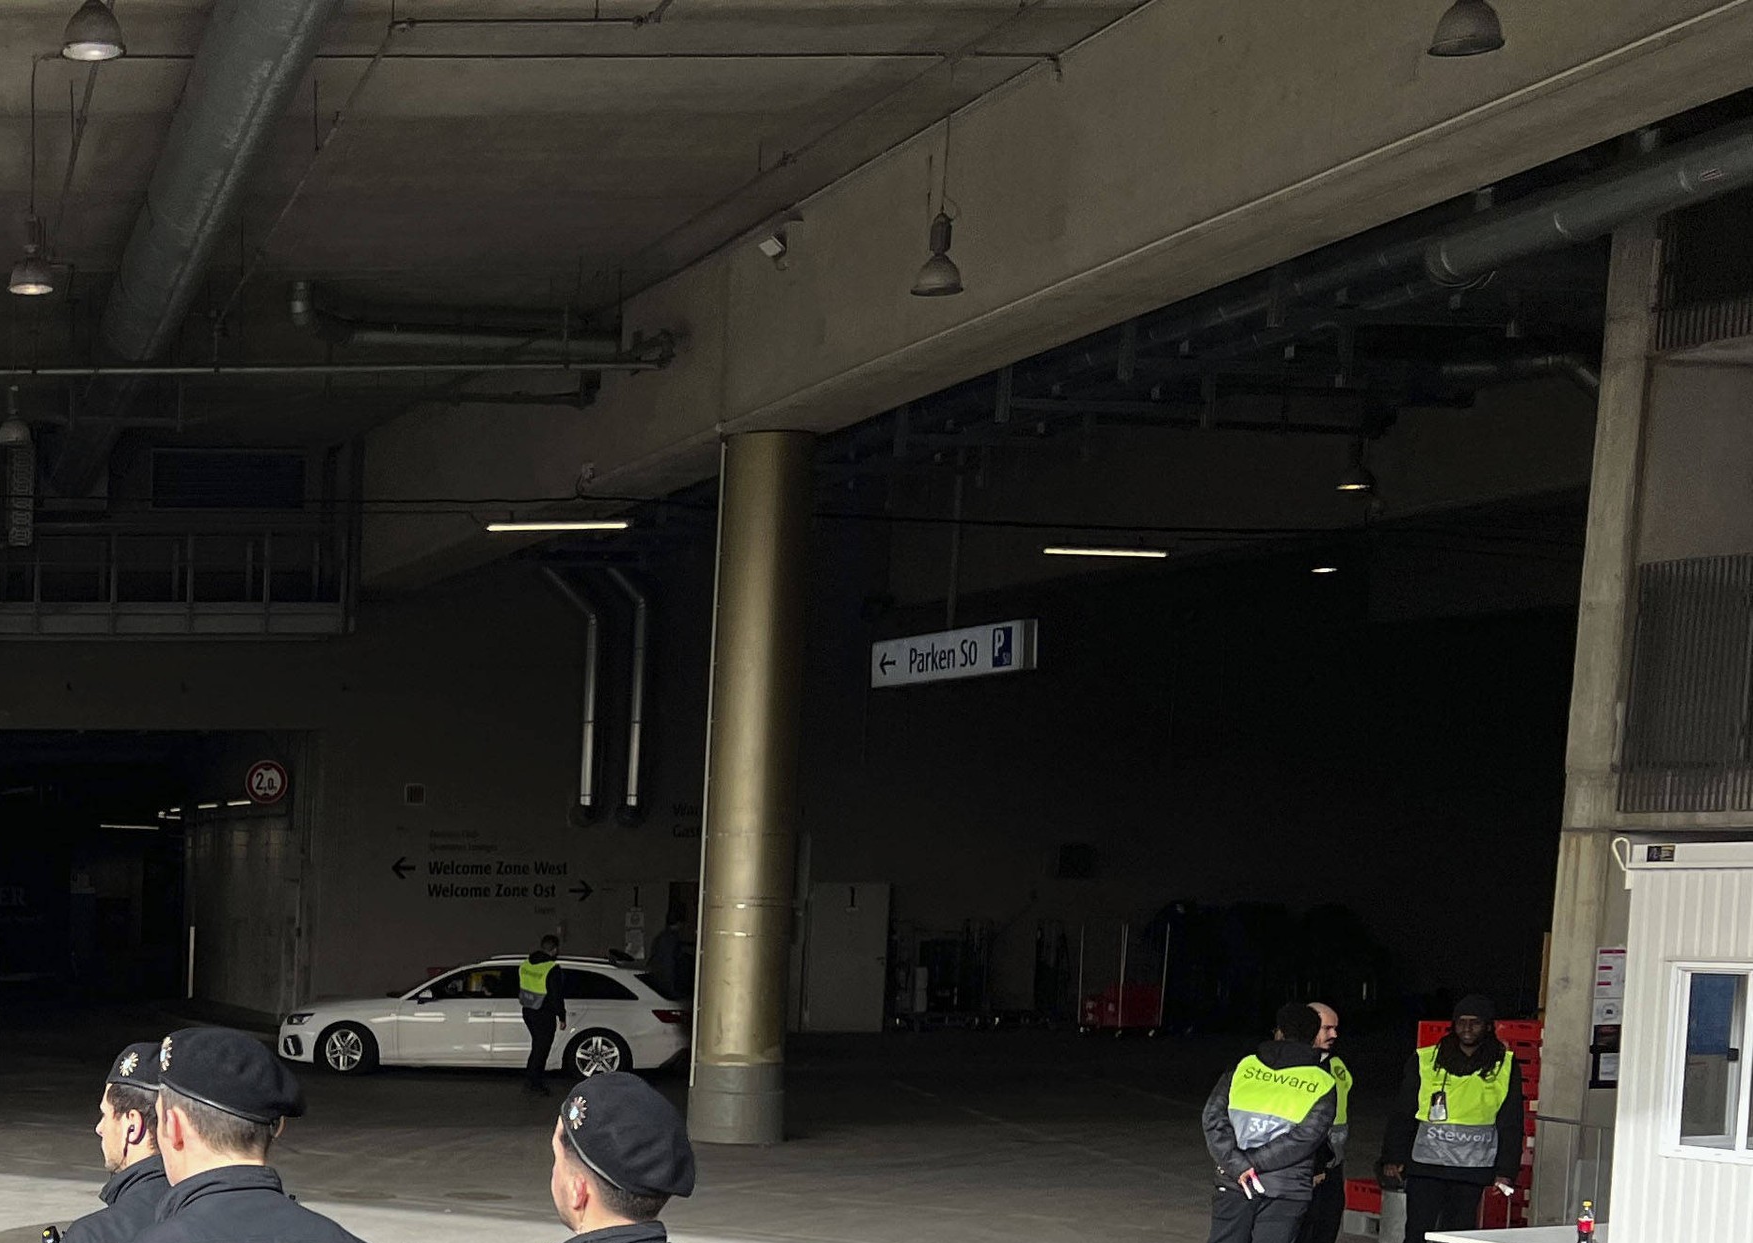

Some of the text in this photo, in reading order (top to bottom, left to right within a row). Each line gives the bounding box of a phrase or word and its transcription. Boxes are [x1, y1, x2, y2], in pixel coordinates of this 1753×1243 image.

[909, 639, 977, 674] Parken SO
[427, 861, 568, 876] Welcome Zone West
[427, 884, 557, 899] Welcome Zone Ost
[1243, 1066, 1320, 1093] Steward
